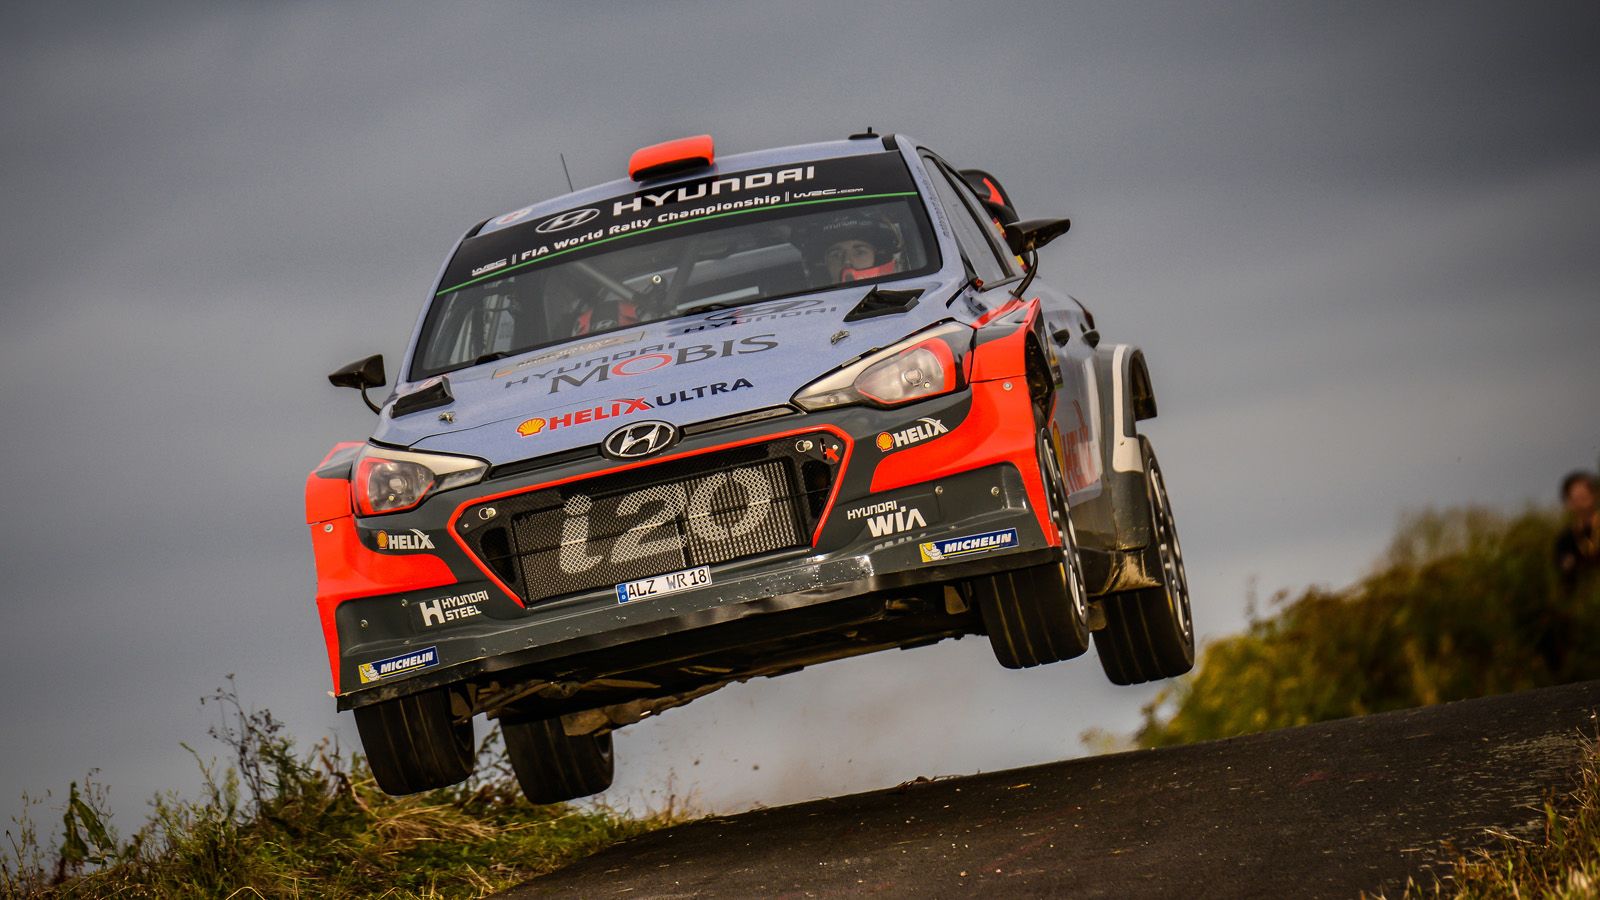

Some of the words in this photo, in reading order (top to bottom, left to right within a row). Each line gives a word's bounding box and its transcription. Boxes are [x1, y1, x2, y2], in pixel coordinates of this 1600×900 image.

[613, 166, 815, 216] HYUNDAI
[521, 246, 549, 261] FIA
[554, 231, 603, 250] World
[608, 217, 652, 235] Rally
[658, 195, 781, 223] Championship
[684, 307, 837, 334] HYUNDAI
[505, 342, 676, 390] HYUNDAI
[547, 333, 780, 395] MOBIS
[549, 397, 655, 430] HELIX
[656, 377, 754, 406] ULTRA
[893, 417, 949, 448] HELIX
[560, 467, 771, 574] i20
[847, 500, 898, 520] HYUNDAI
[388, 528, 435, 549] HELIX
[943, 532, 1012, 552] MICHELIN
[628, 579, 658, 599] ALZ
[666, 573, 688, 591] WR
[691, 568, 707, 586] 18
[442, 590, 489, 609] HYUNDAI
[445, 605, 482, 621] STEEL
[380, 651, 433, 674] MICHELIN
